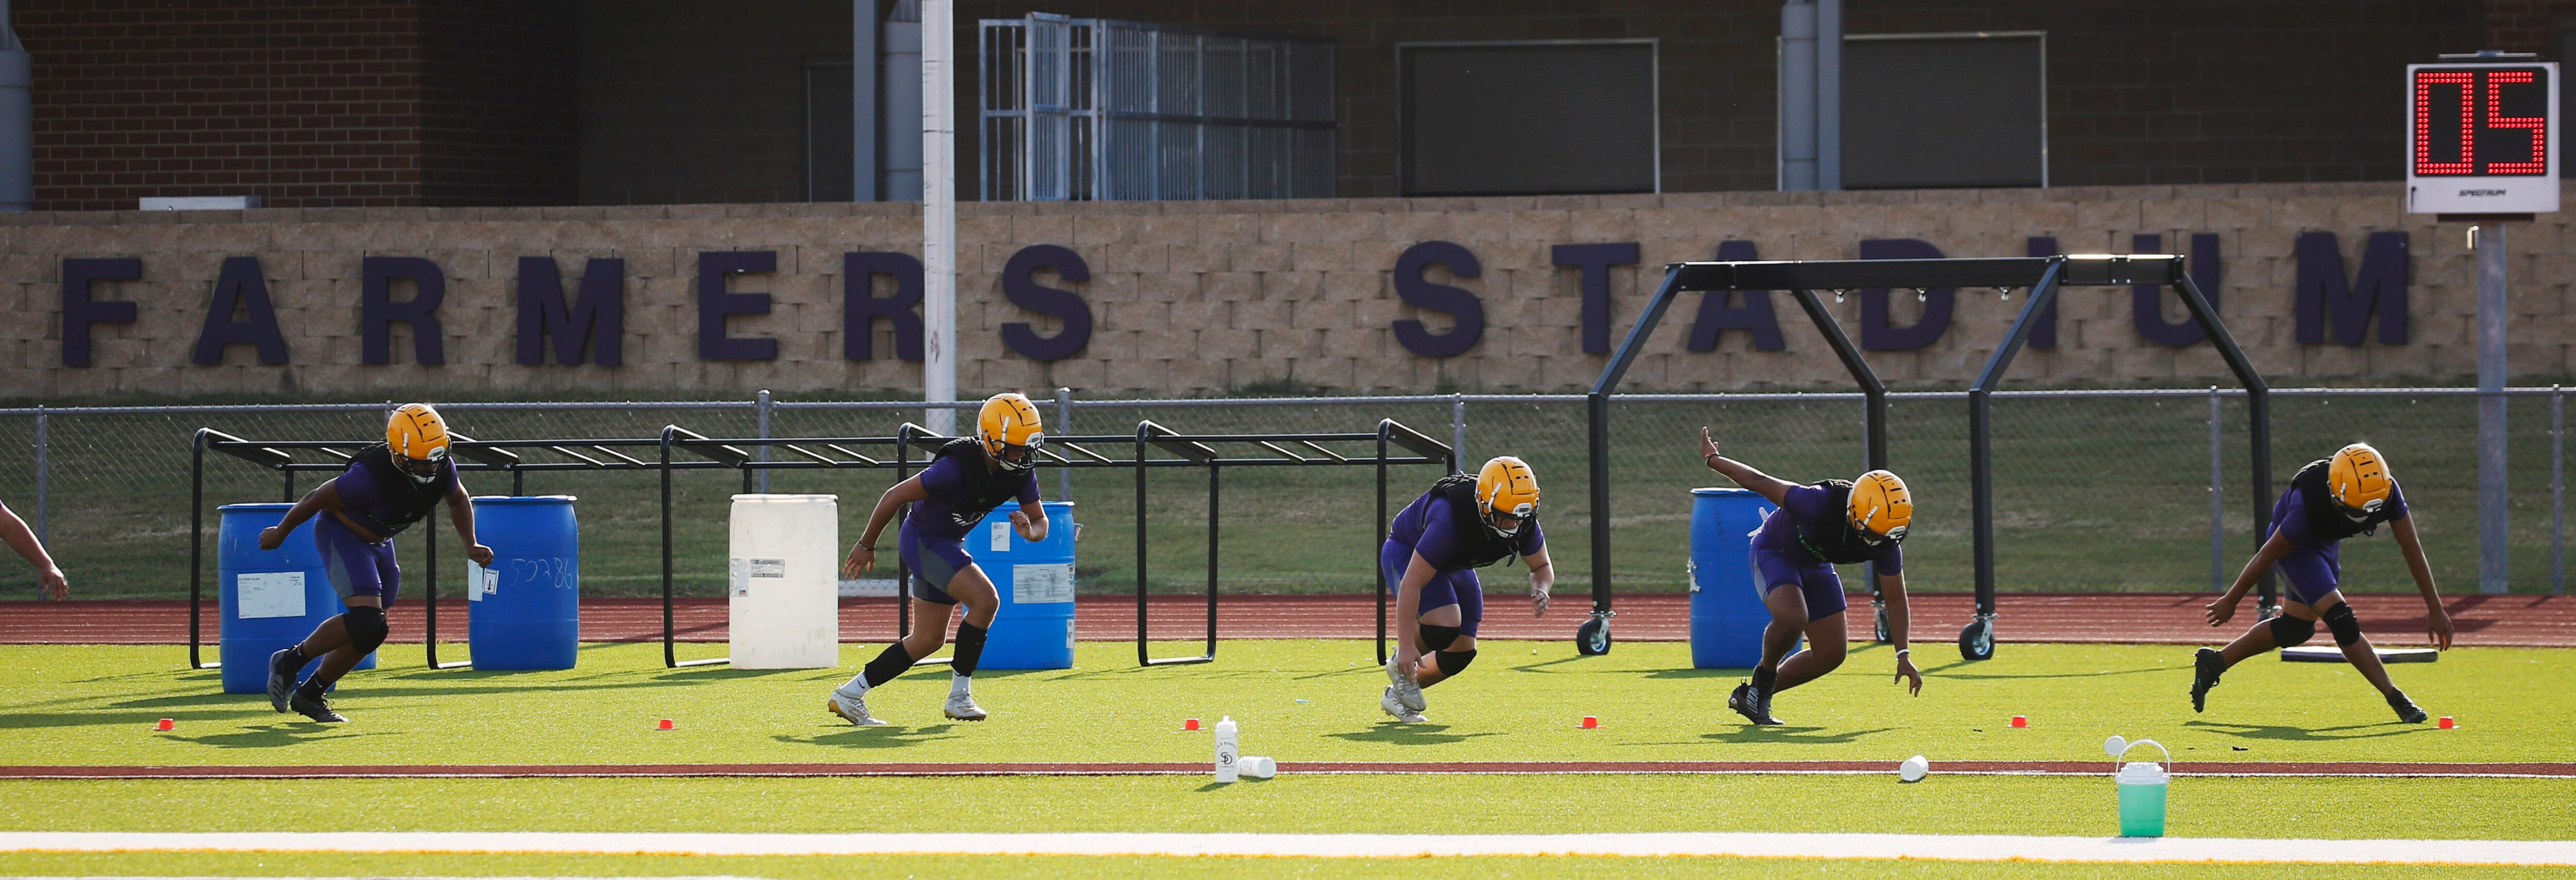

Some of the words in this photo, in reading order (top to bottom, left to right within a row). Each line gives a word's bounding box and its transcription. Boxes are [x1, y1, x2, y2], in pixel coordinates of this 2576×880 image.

[2416, 72, 2545, 175] 05
[2459, 189, 2506, 197] SPECTRUM
[62, 243, 1092, 367] FARMERS
[1392, 231, 2410, 358] STADIUM
